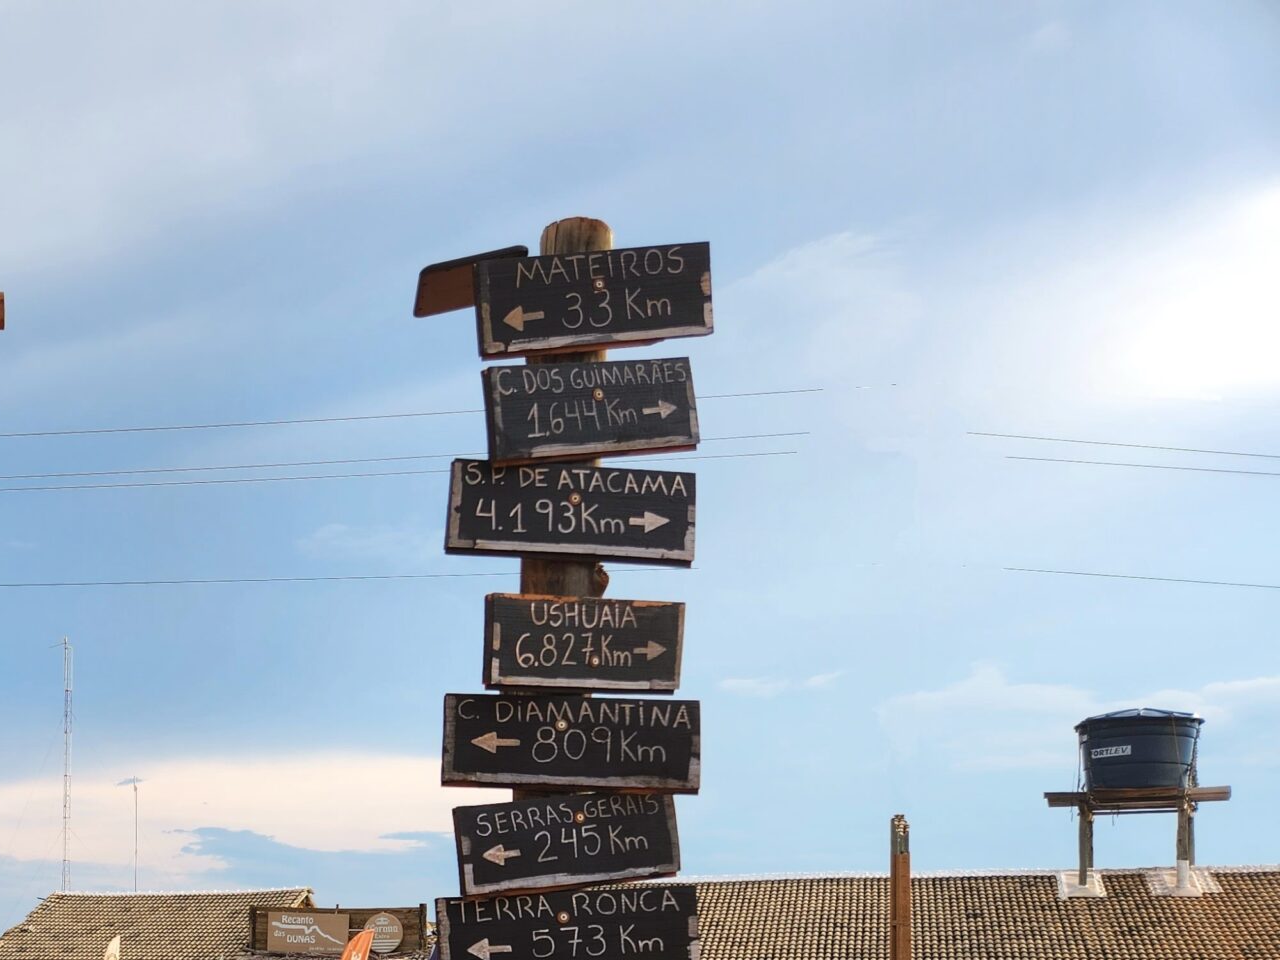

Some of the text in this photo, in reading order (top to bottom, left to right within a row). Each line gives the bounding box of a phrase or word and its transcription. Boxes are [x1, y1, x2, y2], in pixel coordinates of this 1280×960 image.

[516, 246, 684, 288] MATEIROS
[626, 287, 671, 320] Km
[524, 367, 563, 394] DOS
[571, 361, 686, 389] GUIMARÃES
[520, 468, 548, 487] DE
[557, 469, 687, 497] ATACAMA
[531, 602, 637, 629] USHUAIA
[496, 700, 691, 729] DIAMANTINA
[476, 794, 659, 837] SERRAS GERAIS
[281, 915, 314, 925] Recanto
[450, 890, 680, 924] TERRA RONCA
[287, 934, 316, 944] DUNAS
